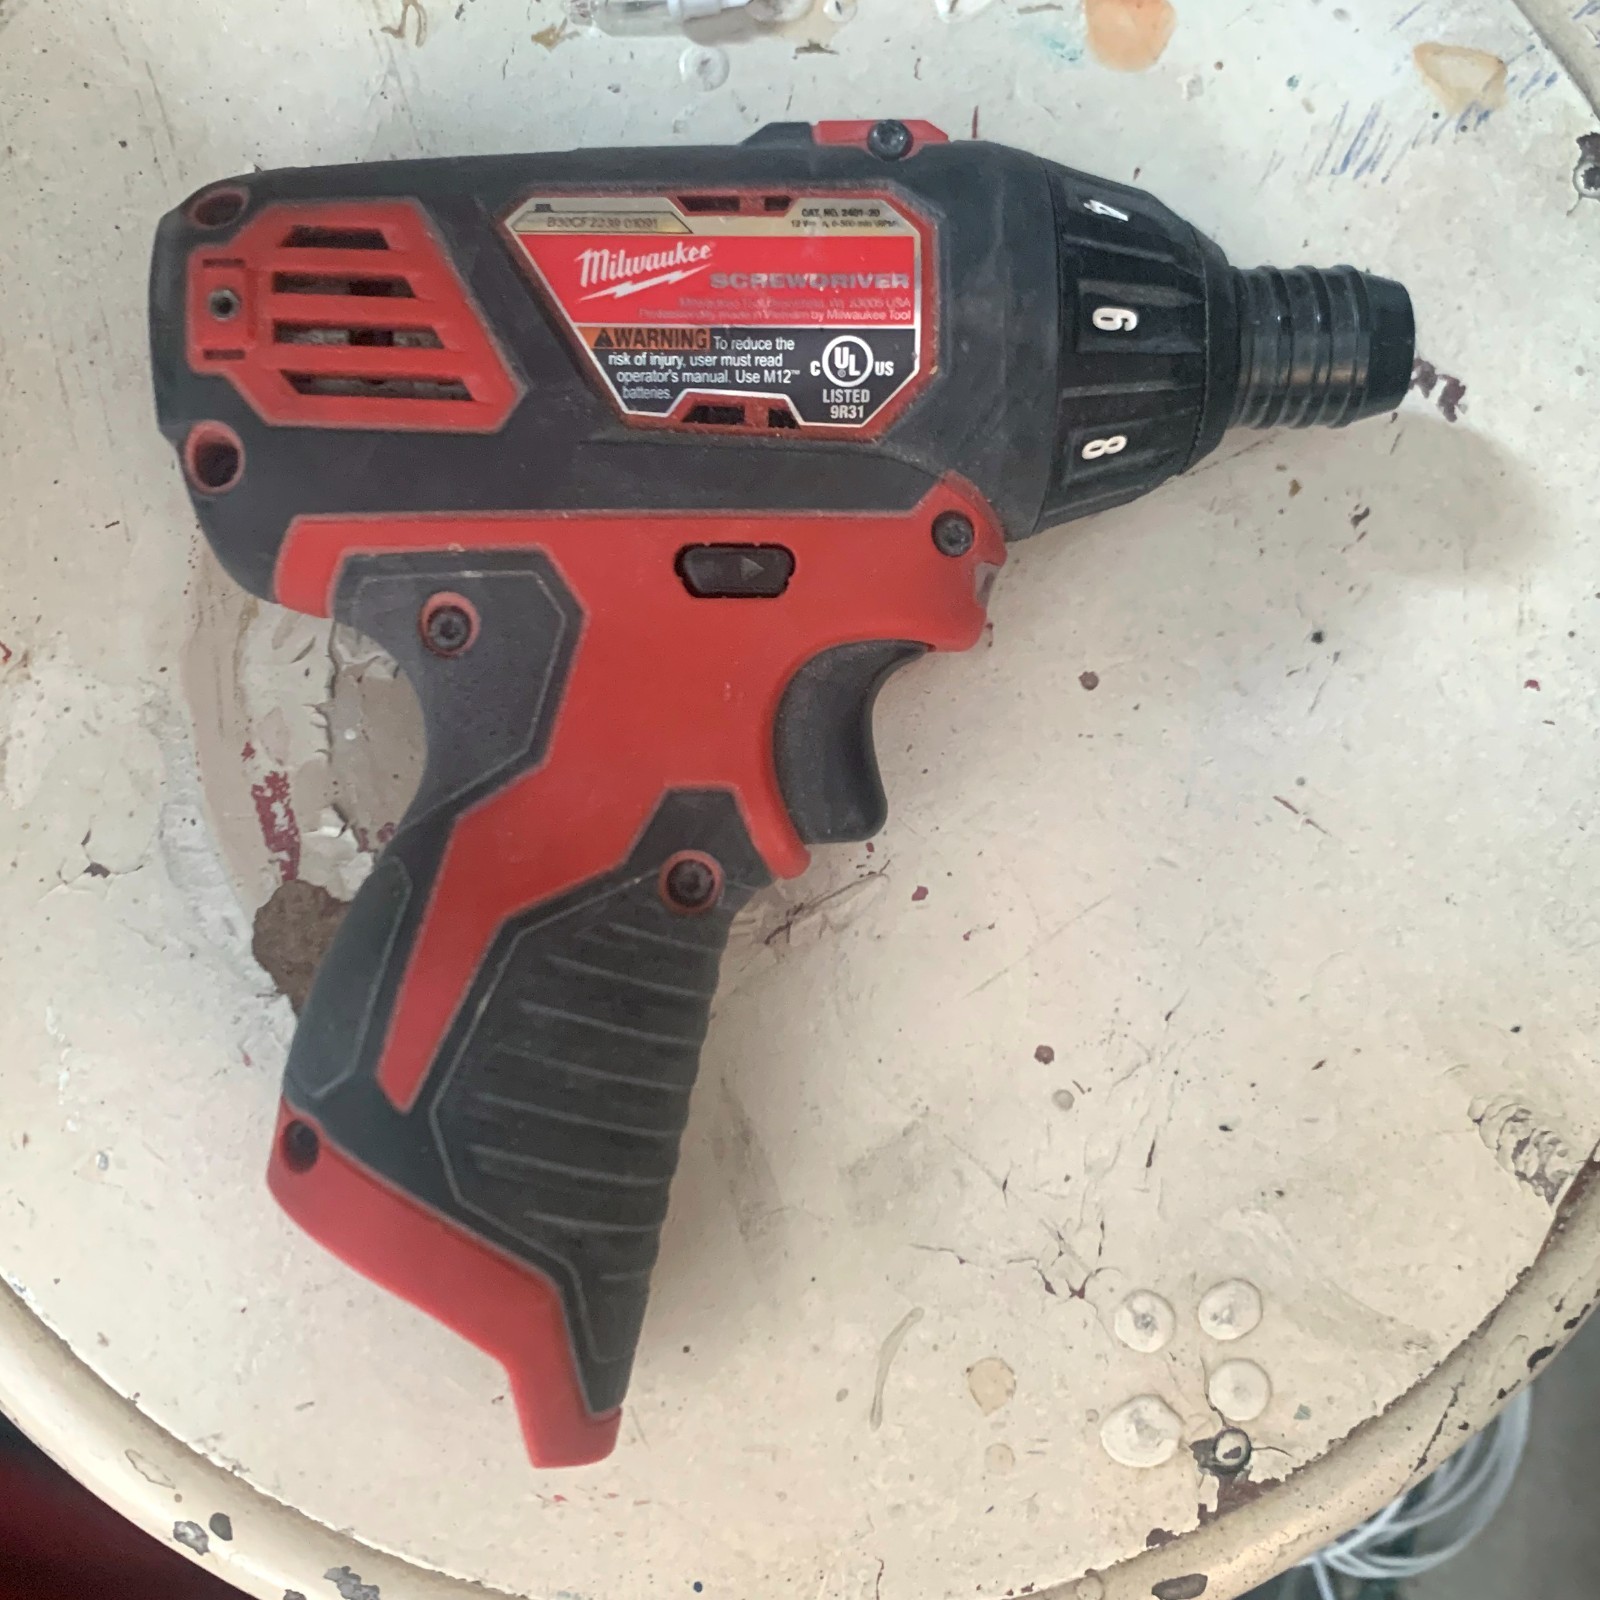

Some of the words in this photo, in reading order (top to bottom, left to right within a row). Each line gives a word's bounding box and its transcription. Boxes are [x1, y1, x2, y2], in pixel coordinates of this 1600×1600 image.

[1083, 199, 1129, 222] 4
[574, 241, 714, 288] Milwaukee
[709, 273, 909, 289] SCREWDRIVER
[886, 297, 911, 308] USA
[810, 312, 824, 322] by
[826, 309, 887, 320] Milwaukee
[889, 309, 912, 320] Tool
[1092, 306, 1139, 332] 6
[613, 329, 708, 348] WARNING
[713, 336, 728, 350] To
[731, 338, 773, 350] reduce
[775, 337, 796, 350] the
[608, 353, 631, 366] risk
[633, 353, 647, 366] of
[649, 353, 687, 369] injury,
[689, 355, 717, 367] user
[720, 355, 752, 367] must
[754, 354, 783, 367] read
[616, 370, 679, 386] operator's
[681, 370, 732, 384] manual.
[735, 371, 761, 384] Use
[622, 385, 674, 400] batteries.
[822, 389, 870, 403] LISTED
[830, 405, 864, 419] 9R31
[1081, 435, 1128, 460] 8
